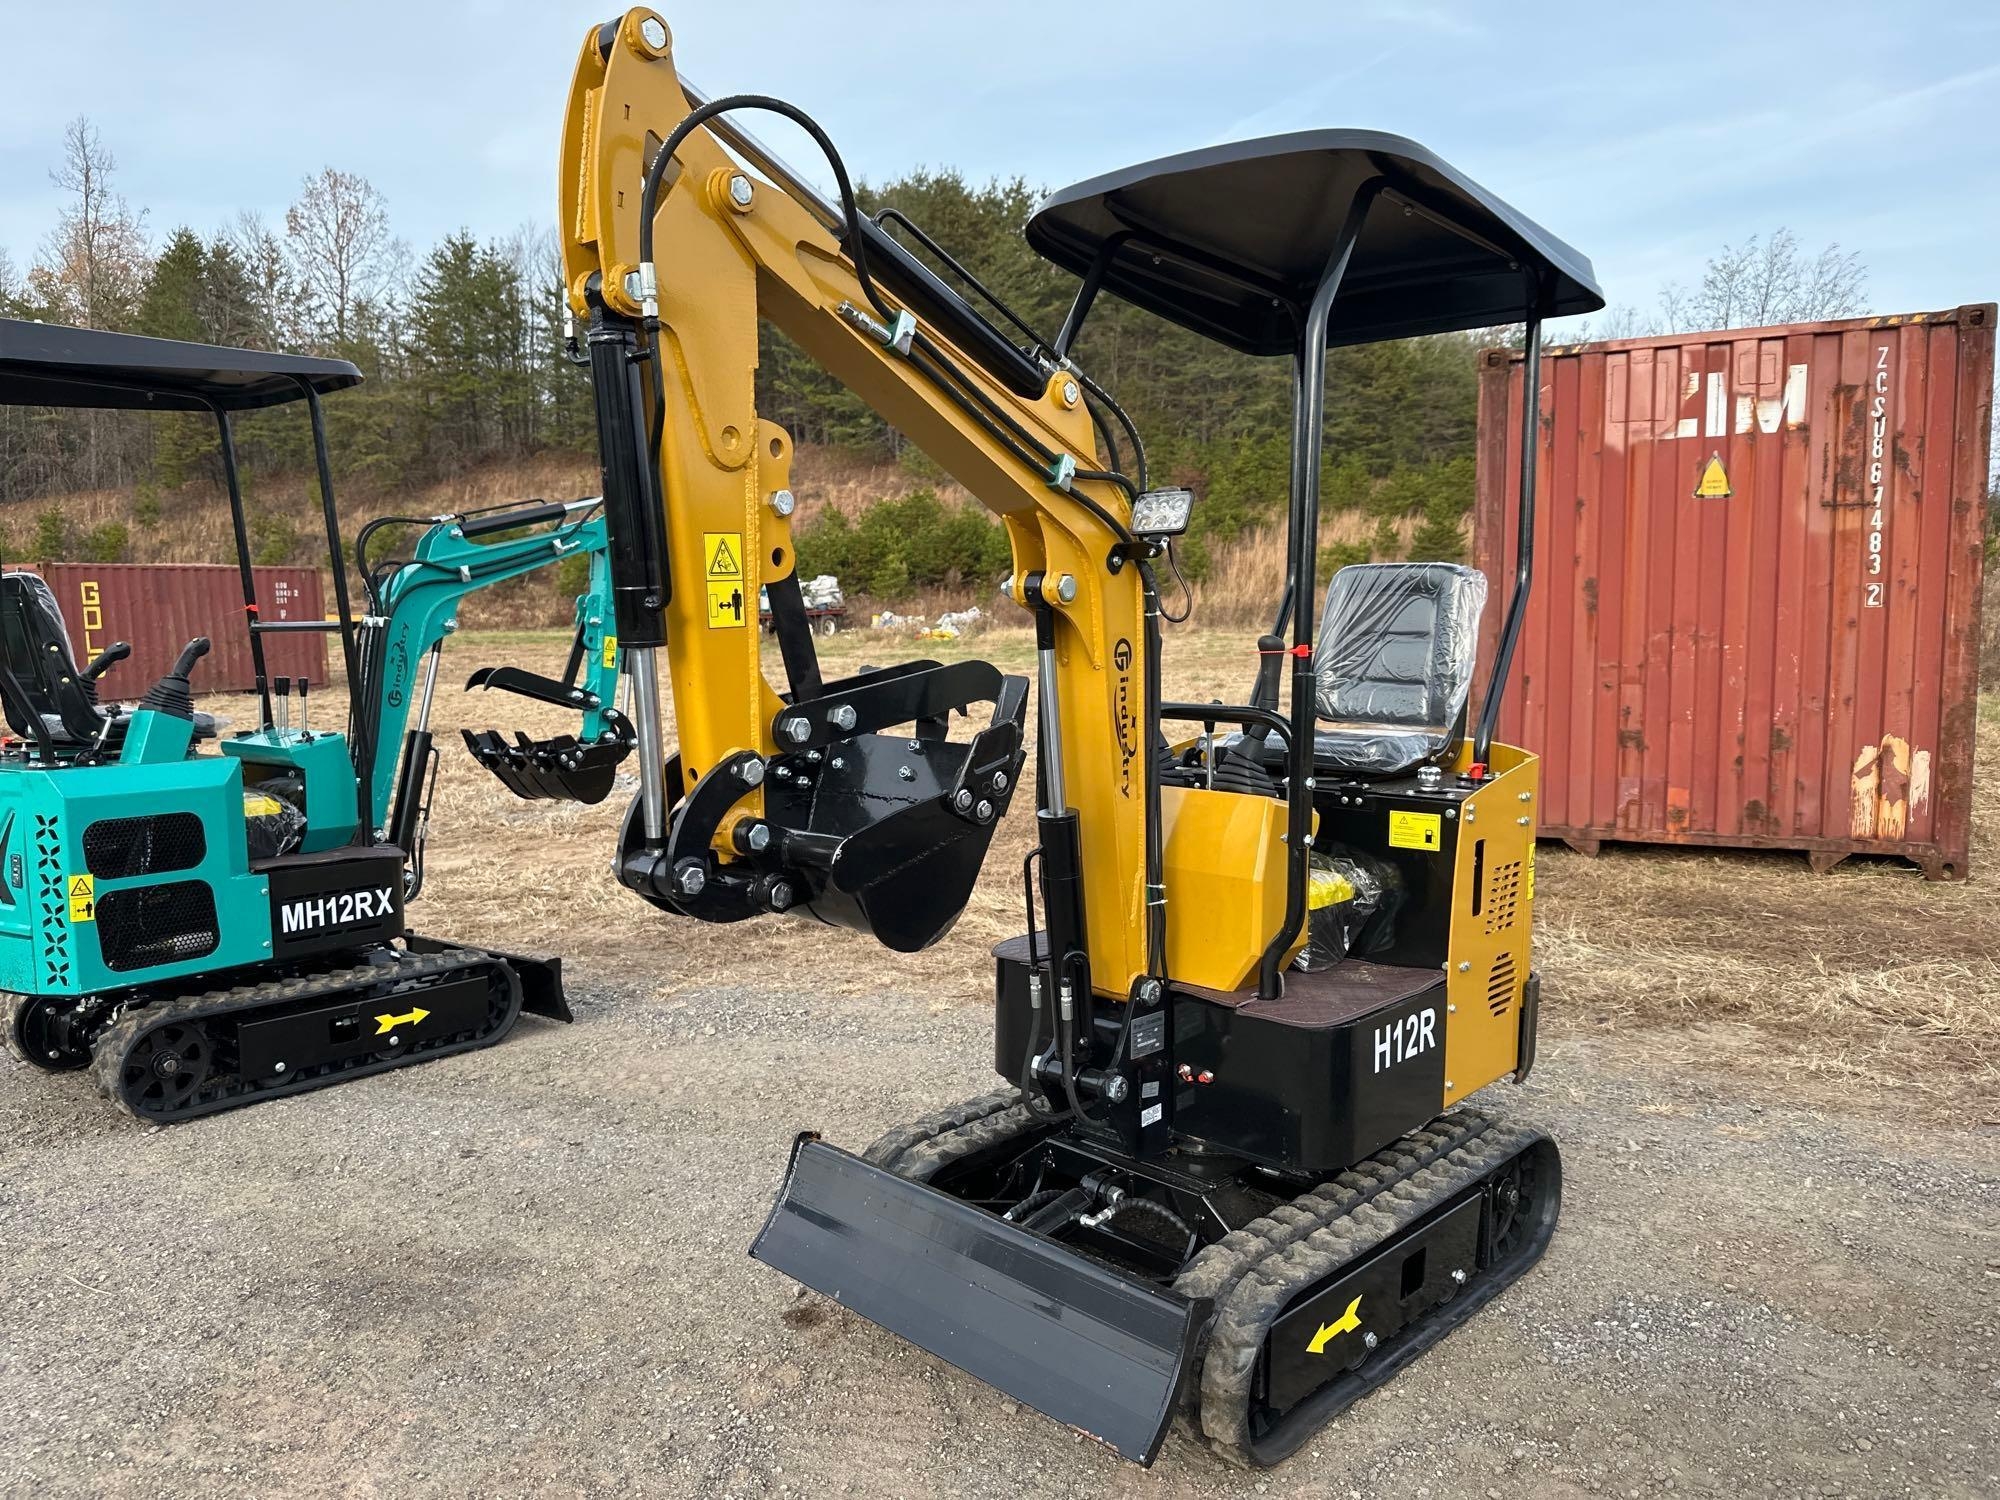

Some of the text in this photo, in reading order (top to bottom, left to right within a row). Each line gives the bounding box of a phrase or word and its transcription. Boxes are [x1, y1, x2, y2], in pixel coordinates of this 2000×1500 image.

[1866, 583, 1882, 606] 2
[281, 887, 395, 934] MH12RX
[1374, 1007, 1436, 1075] H12R
